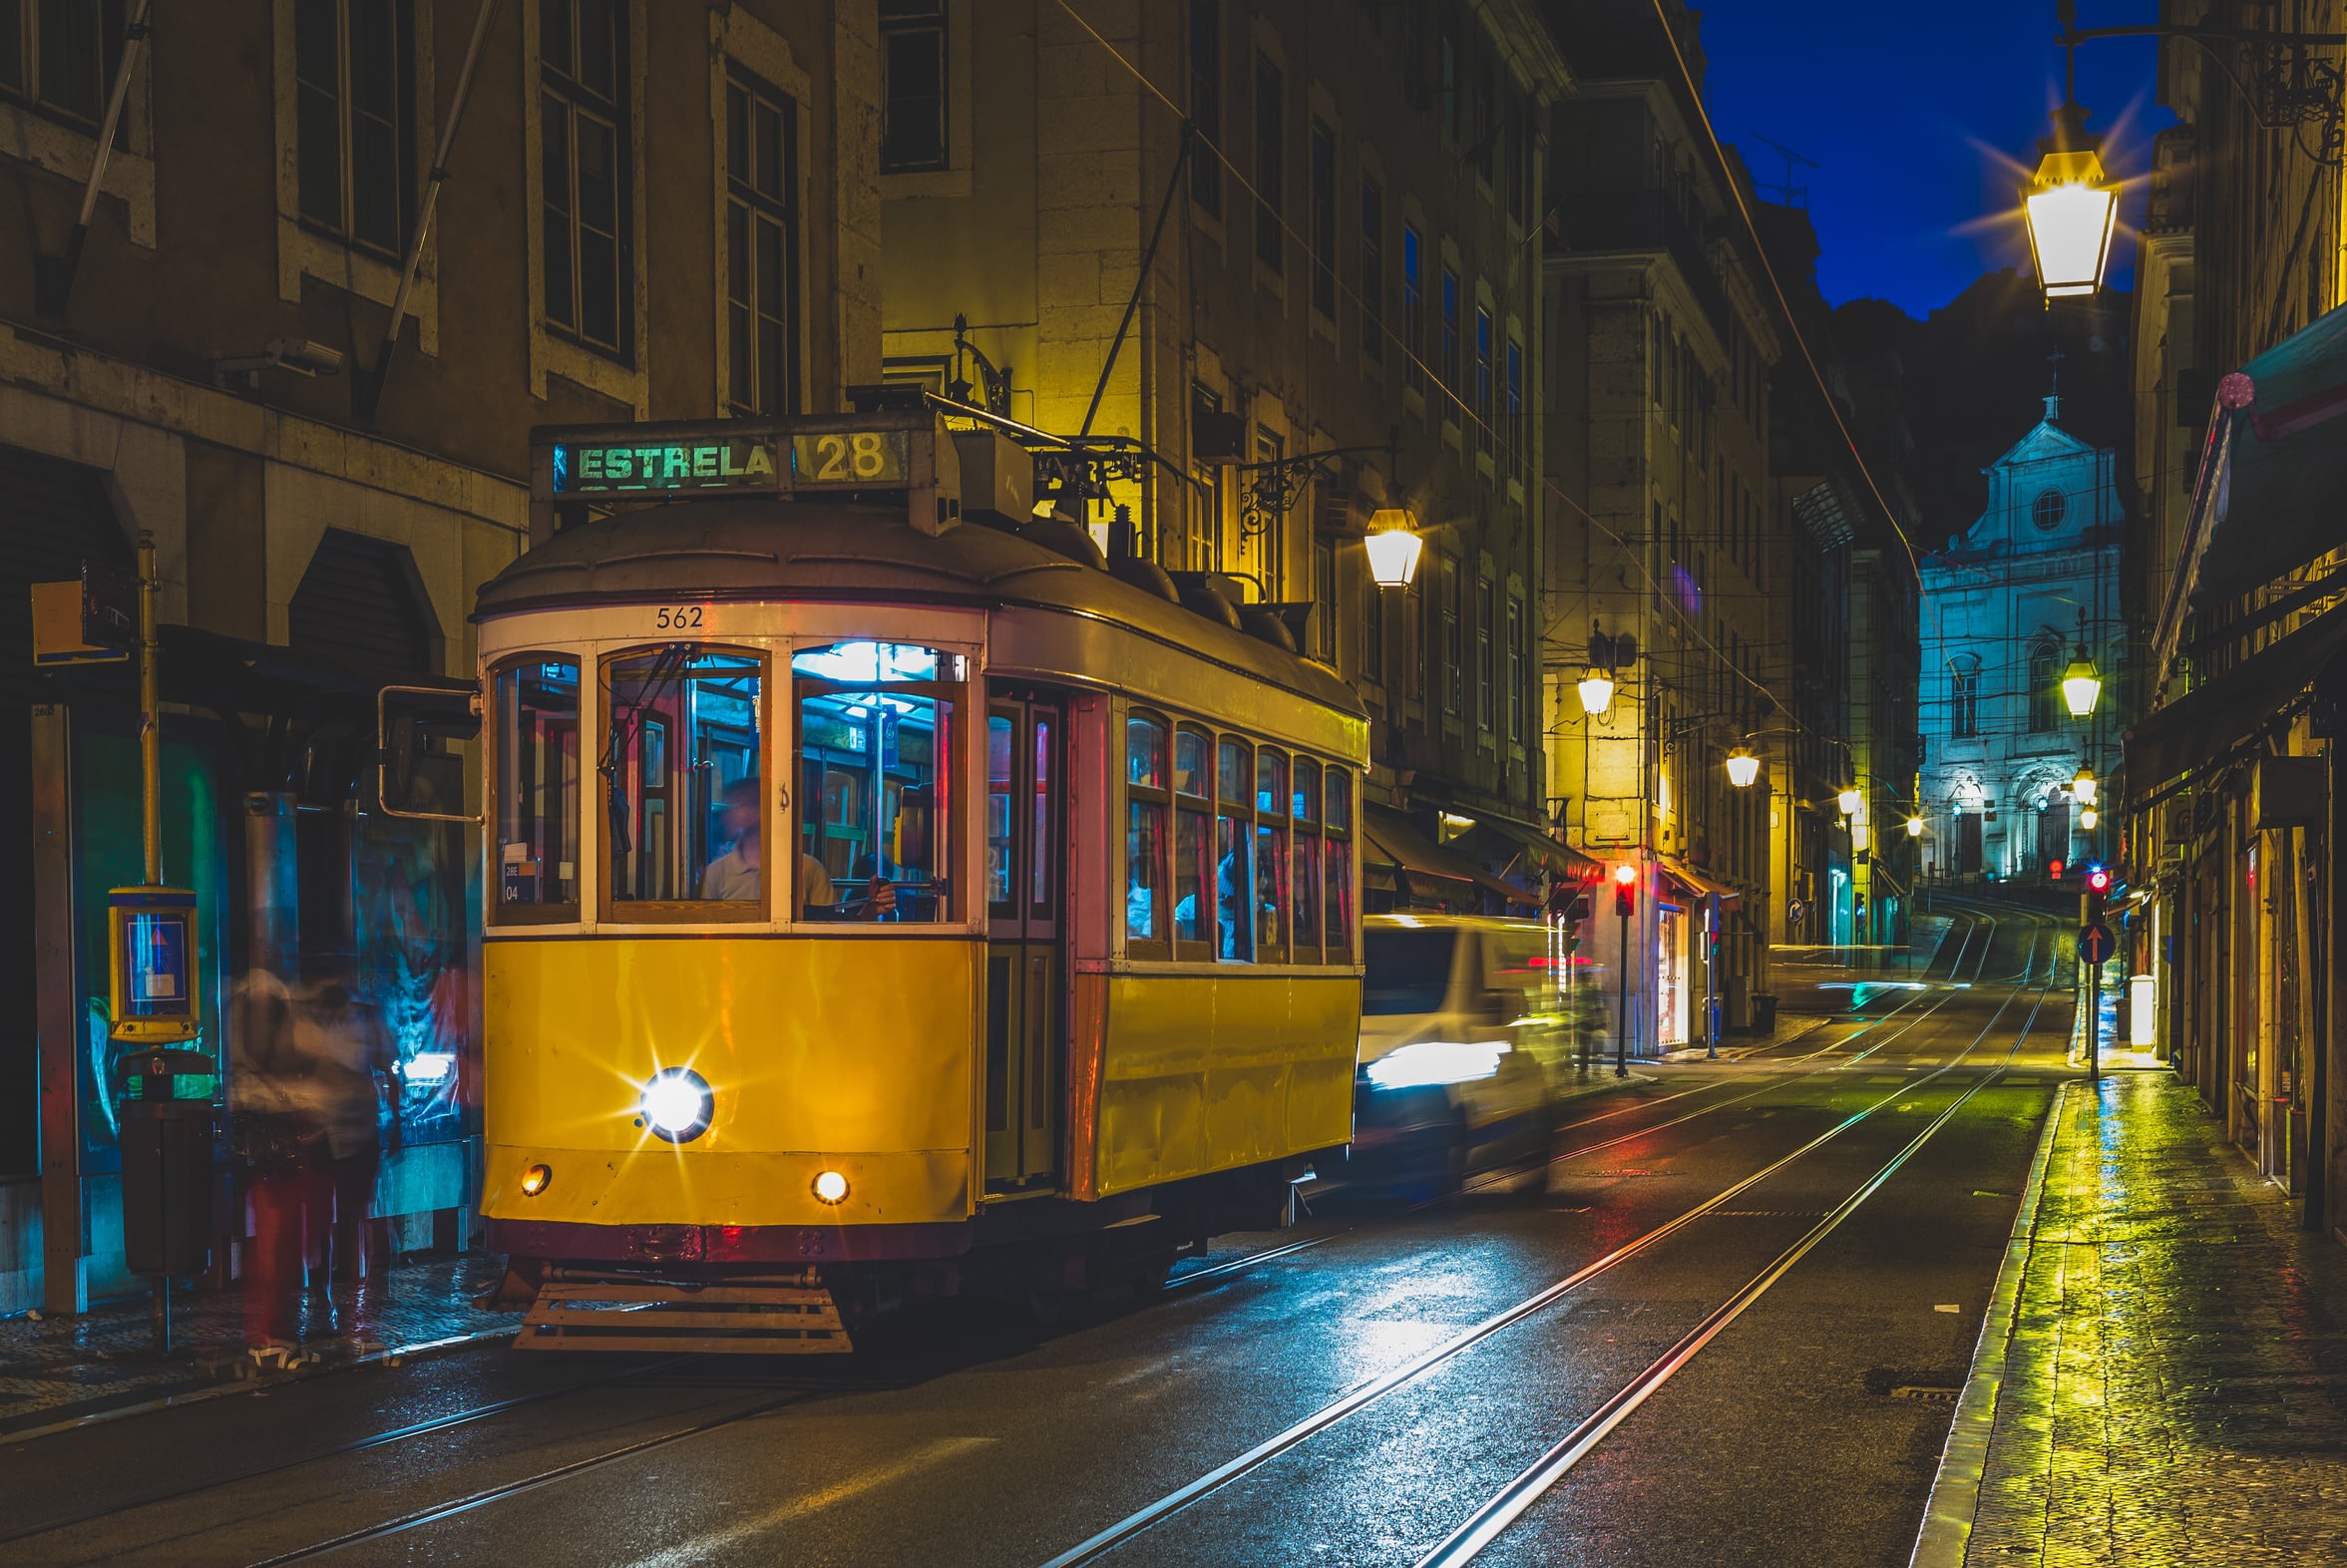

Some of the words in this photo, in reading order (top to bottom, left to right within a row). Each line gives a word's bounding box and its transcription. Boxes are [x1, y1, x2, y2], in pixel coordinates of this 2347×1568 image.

[579, 445, 774, 480] ESTRELA
[816, 433, 886, 481] 28
[656, 606, 703, 629] 562
[506, 886, 519, 901] 04
